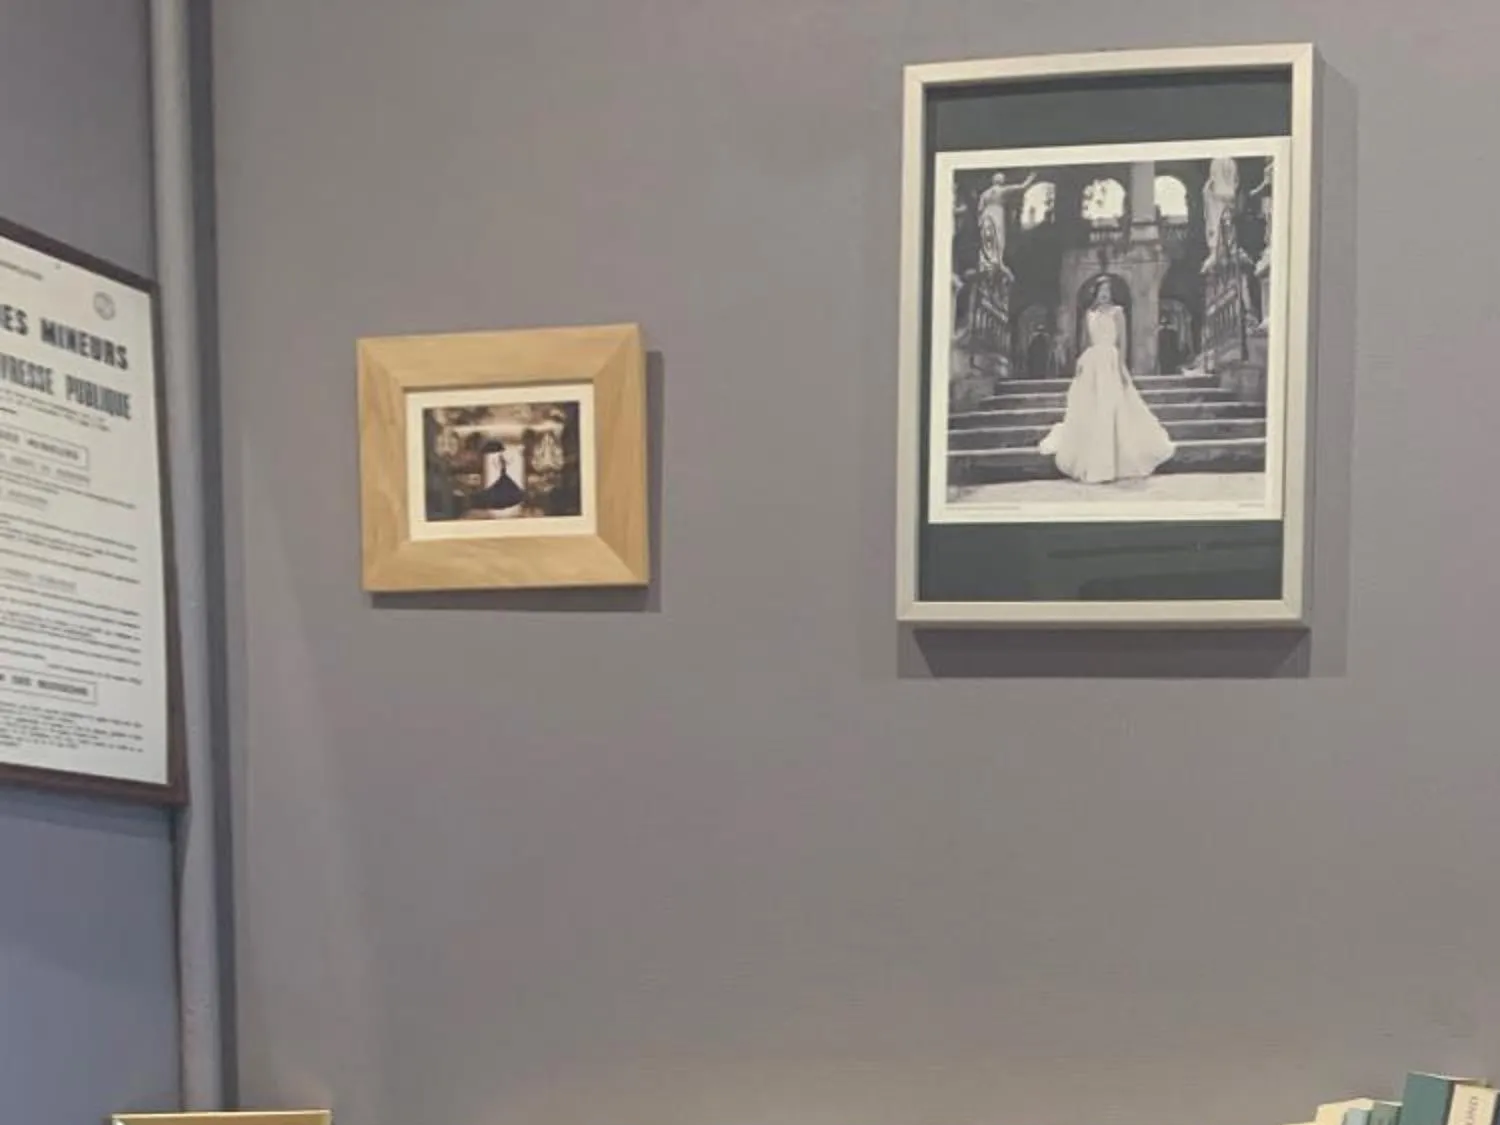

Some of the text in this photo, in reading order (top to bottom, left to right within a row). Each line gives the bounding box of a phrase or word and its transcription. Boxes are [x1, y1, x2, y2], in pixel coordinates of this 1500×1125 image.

[0, 303, 128, 370] ES MINEURS
[65, 373, 131, 419] PUBLIQUE
